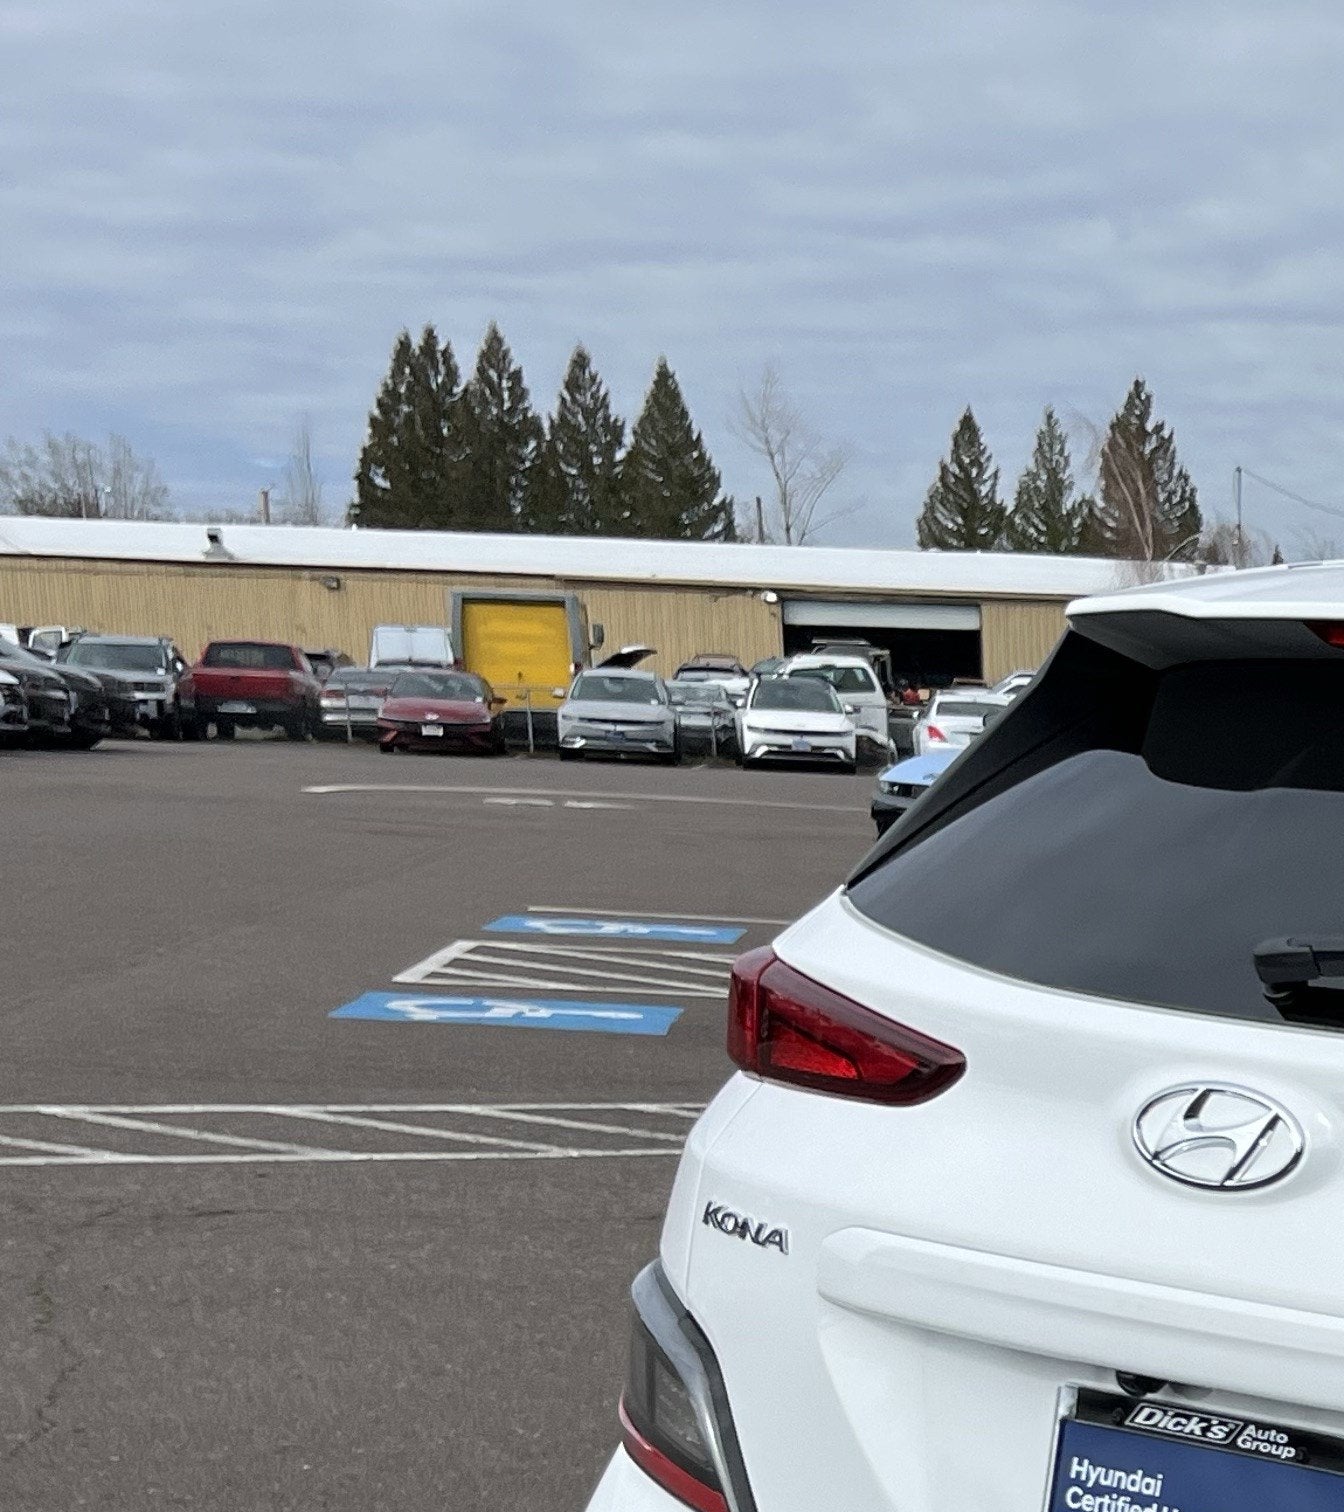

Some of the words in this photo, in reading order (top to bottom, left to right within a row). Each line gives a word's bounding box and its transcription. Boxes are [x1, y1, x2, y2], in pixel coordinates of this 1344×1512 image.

[702, 1200, 790, 1255] KONA
[1133, 1407, 1230, 1439] Dick's
[1242, 1424, 1289, 1444] Auto
[1236, 1434, 1296, 1459] Group
[1069, 1456, 1164, 1498] Hyundai
